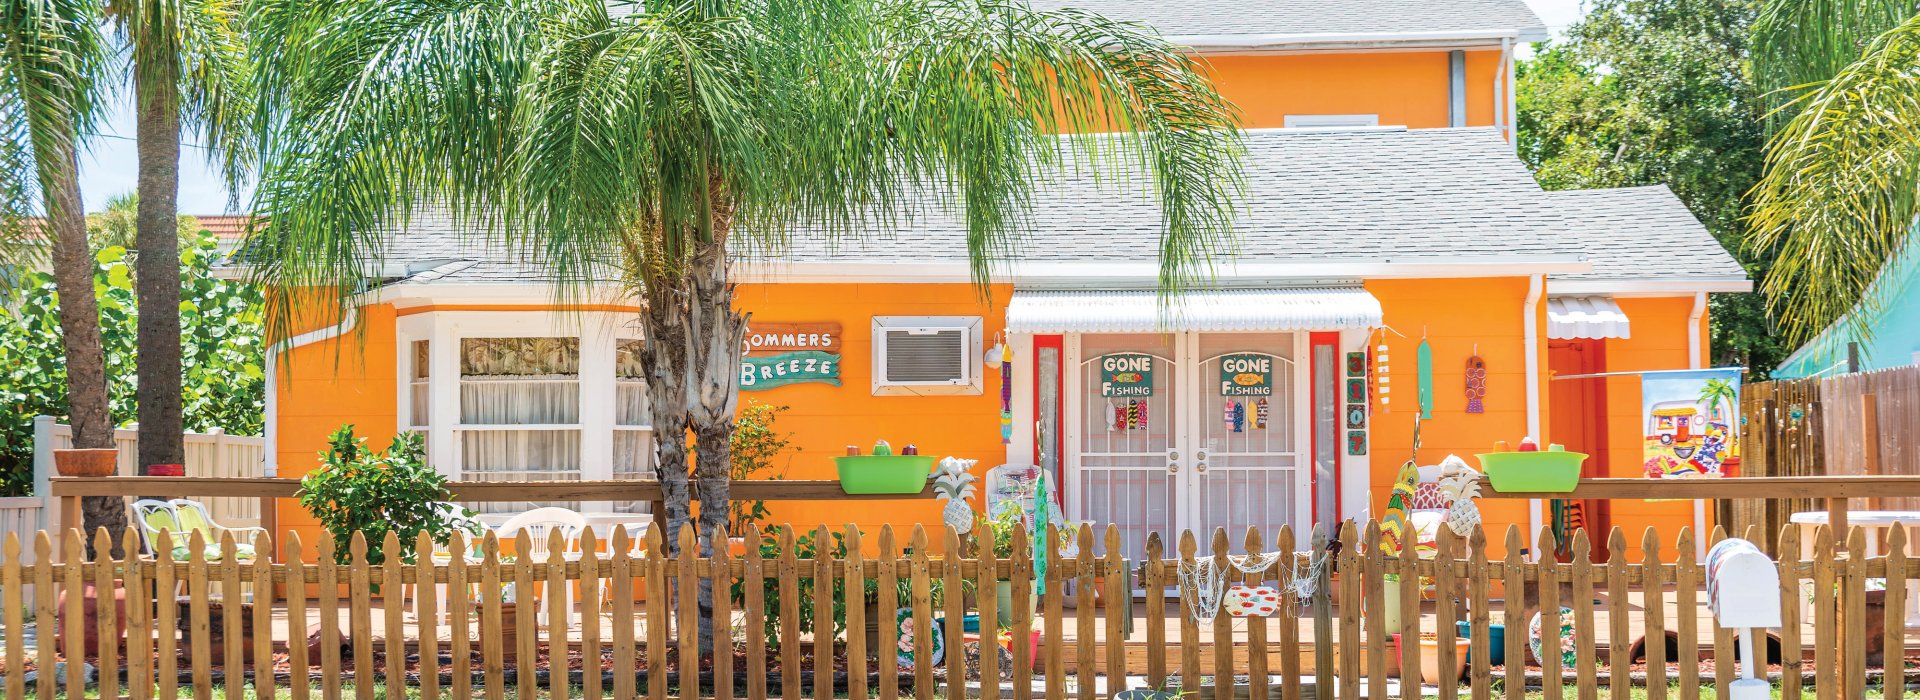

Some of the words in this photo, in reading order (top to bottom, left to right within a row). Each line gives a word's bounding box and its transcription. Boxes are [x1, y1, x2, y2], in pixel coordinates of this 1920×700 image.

[1103, 357, 1151, 371] GONE
[1223, 359, 1270, 372] GONE
[740, 358, 832, 386] BREEZE
[1102, 381, 1150, 396] FISHING
[1222, 380, 1270, 395] FISHING
